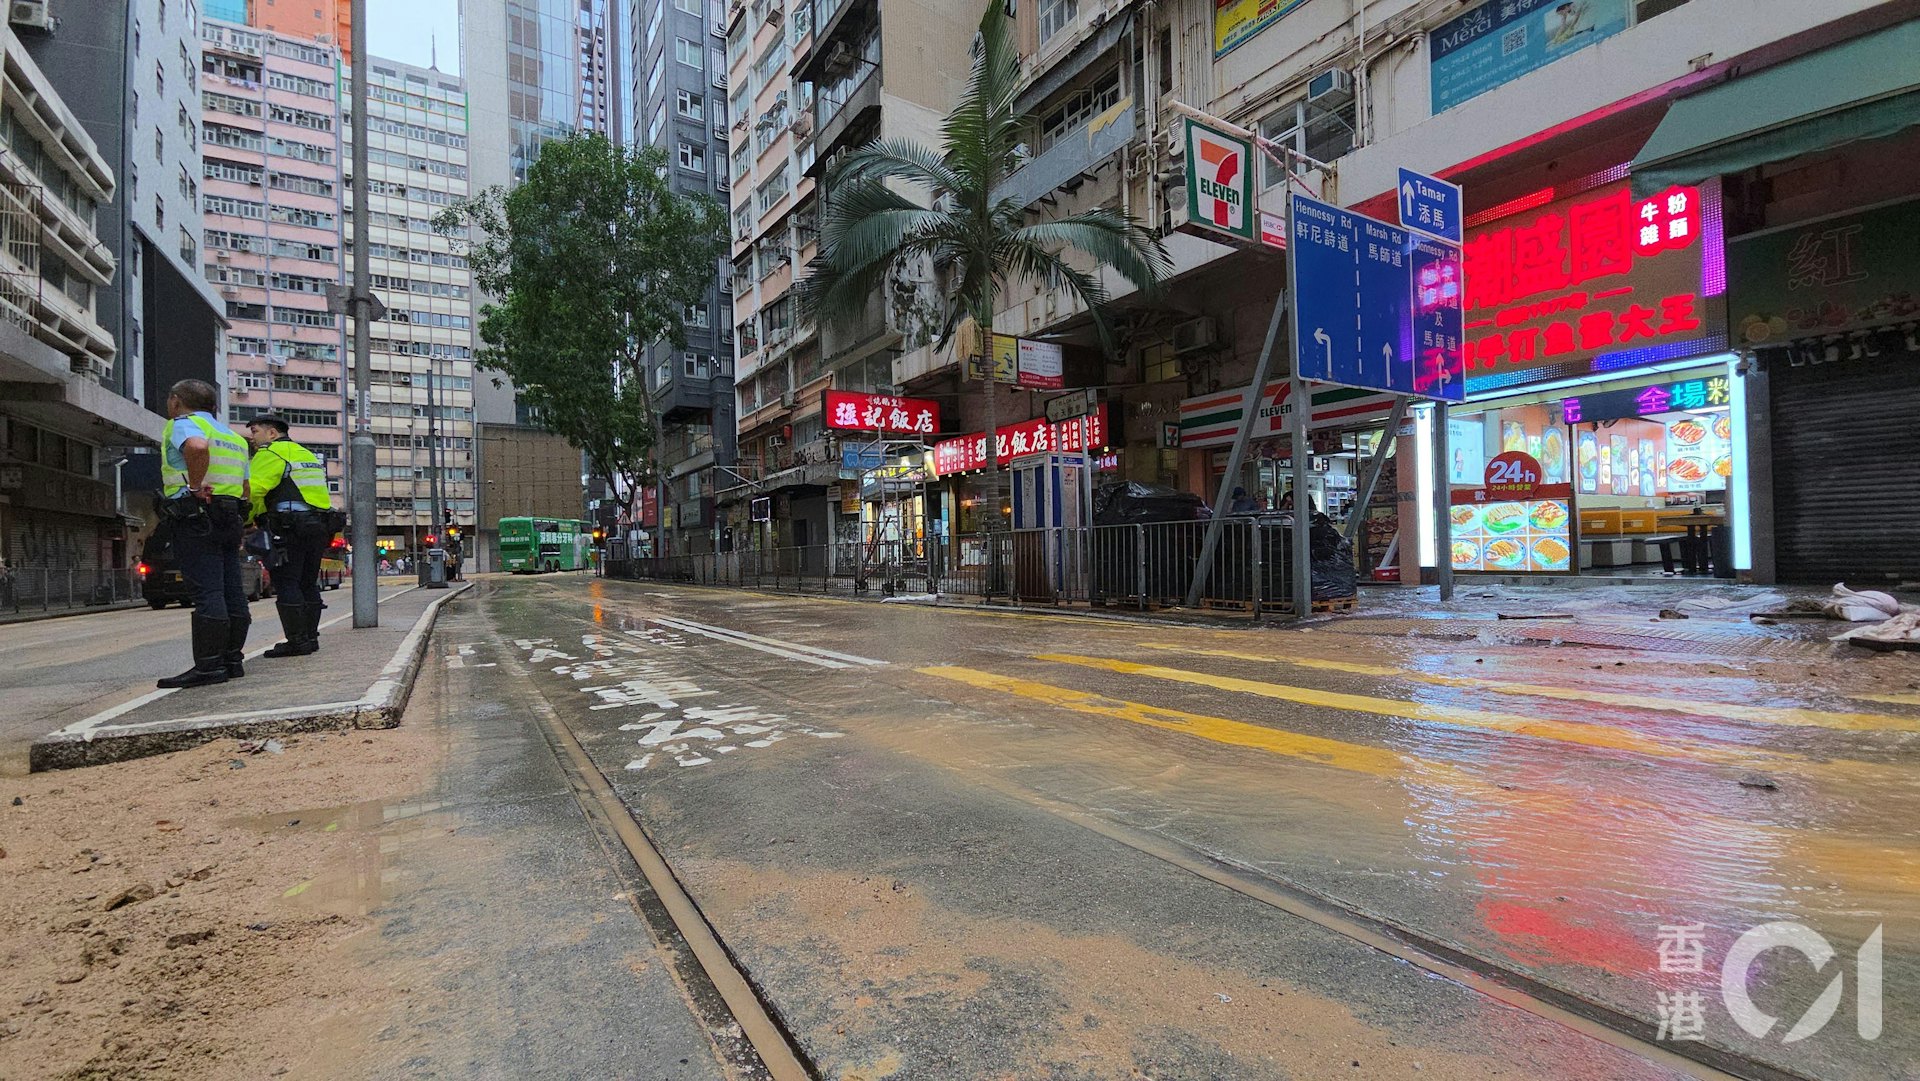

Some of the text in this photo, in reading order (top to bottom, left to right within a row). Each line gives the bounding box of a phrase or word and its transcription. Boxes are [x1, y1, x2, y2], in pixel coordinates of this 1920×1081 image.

[1441, 14, 1493, 53] Merci
[1415, 179, 1446, 203] Tamar
[1295, 199, 1352, 230] Hennessy Rd
[1418, 202, 1445, 230] 添馬
[1296, 220, 1349, 253] 軒尼詩道
[1366, 223, 1402, 245] Marsh Rd
[1368, 242, 1402, 267] 馬師道
[1448, 249, 1458, 262] Rd
[1463, 187, 1633, 311] 潮盛園
[1434, 311, 1444, 327] 及
[1424, 329, 1457, 352] 馬師道
